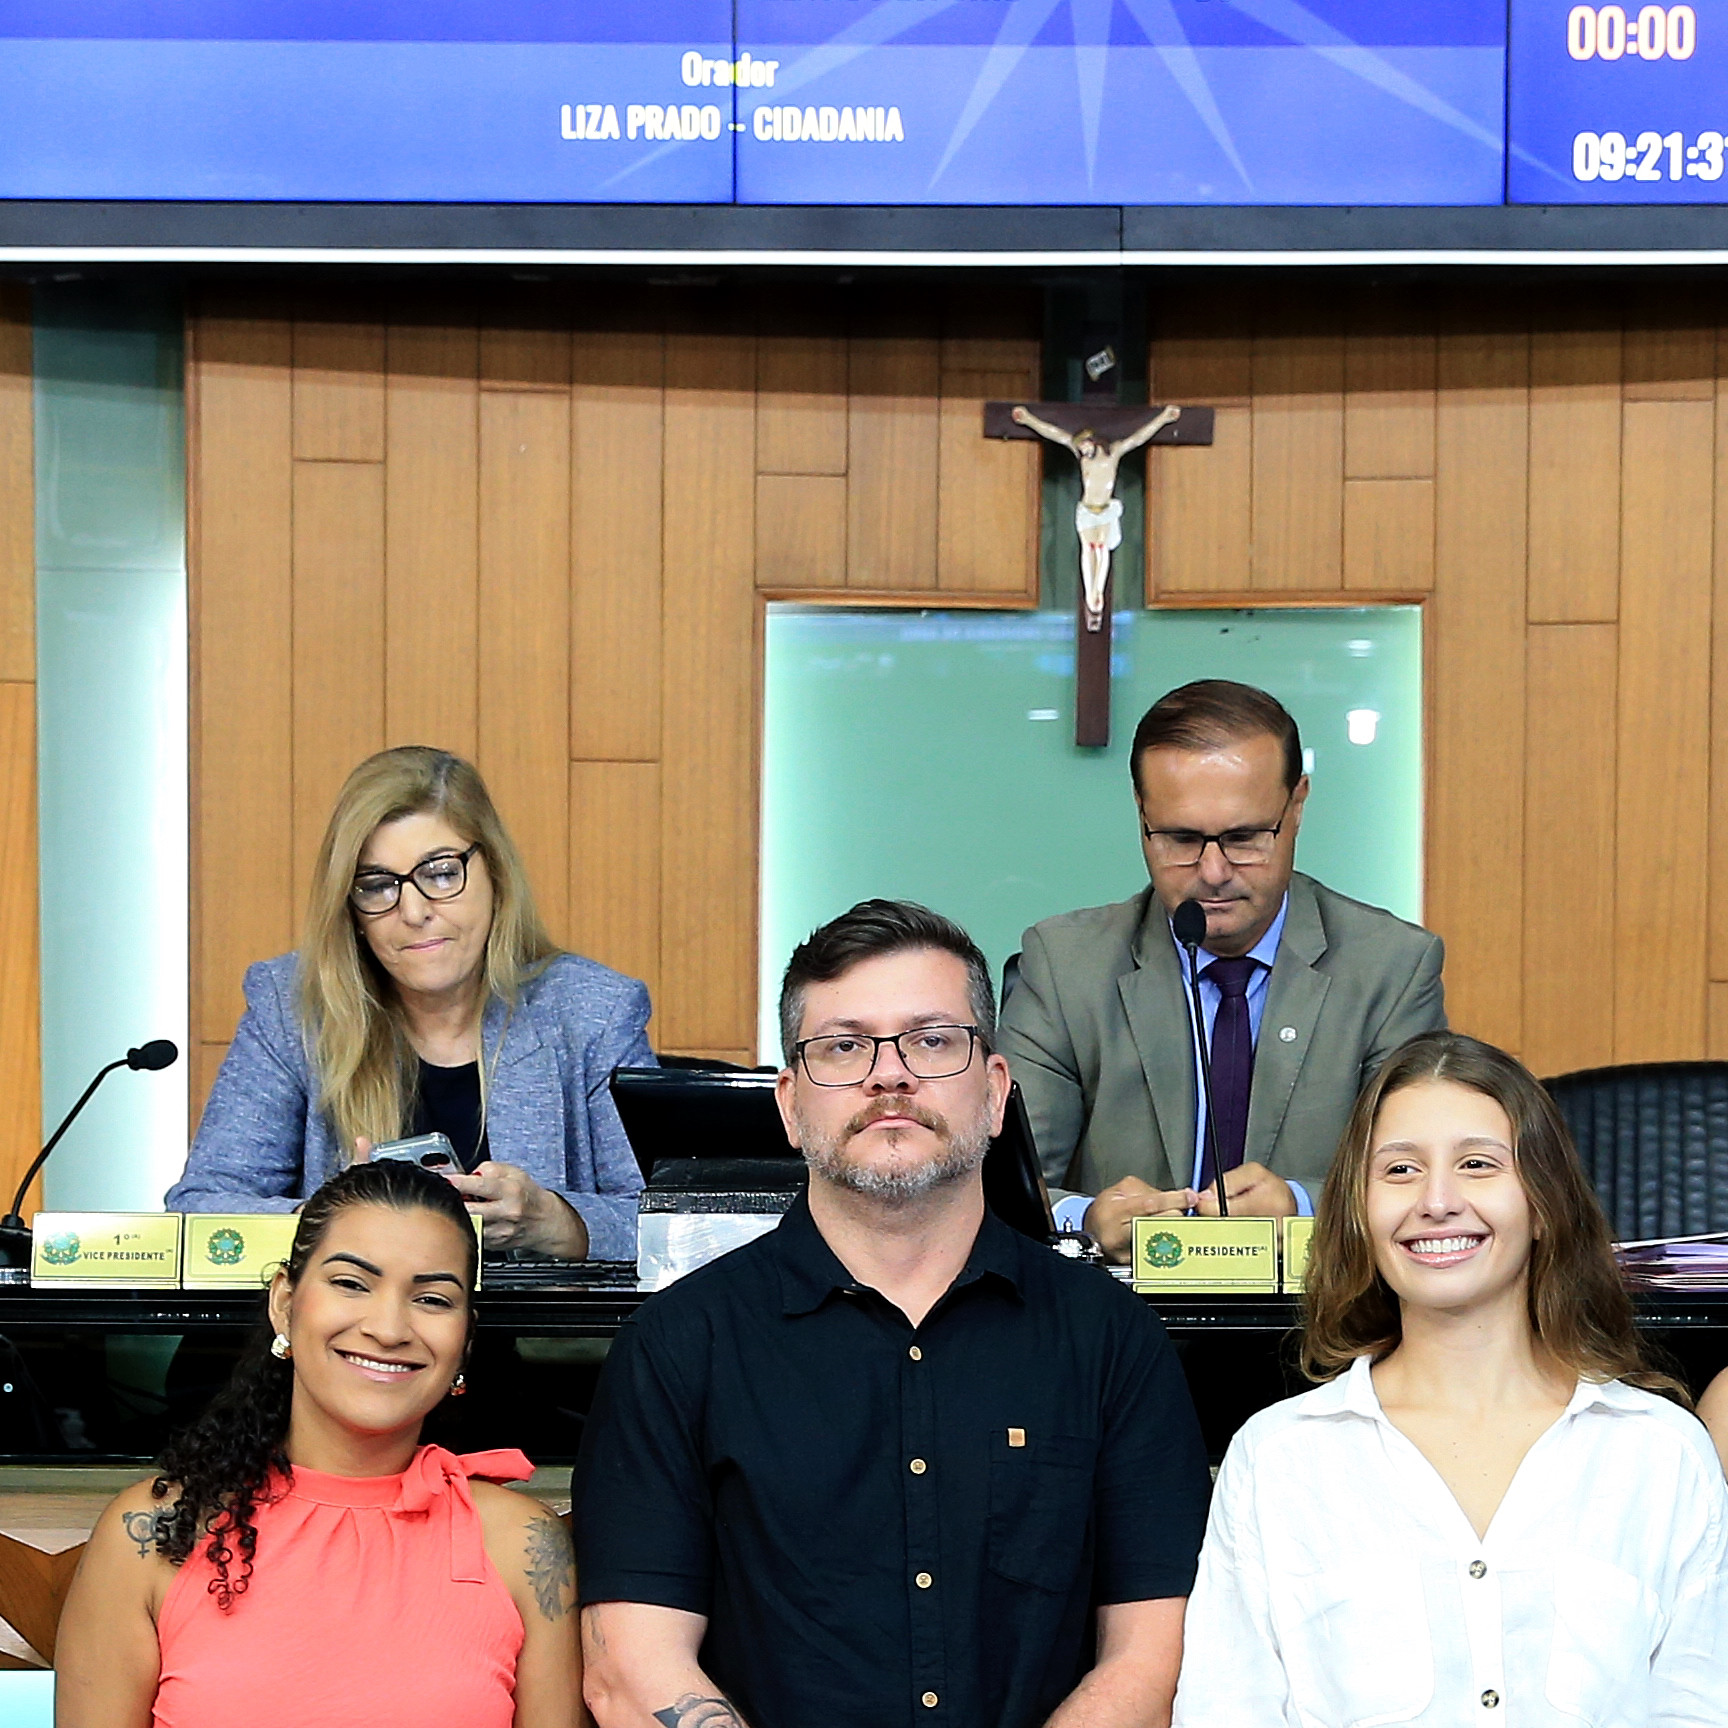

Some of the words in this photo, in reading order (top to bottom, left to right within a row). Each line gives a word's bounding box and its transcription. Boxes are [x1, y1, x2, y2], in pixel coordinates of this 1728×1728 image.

[1567, 4, 1697, 61] 00:00
[681, 50, 780, 88] Orador
[560, 104, 621, 141] LIZA
[626, 104, 721, 141] PRADO
[753, 106, 905, 143] CIDADANIA
[83, 1250, 105, 1261] VICE
